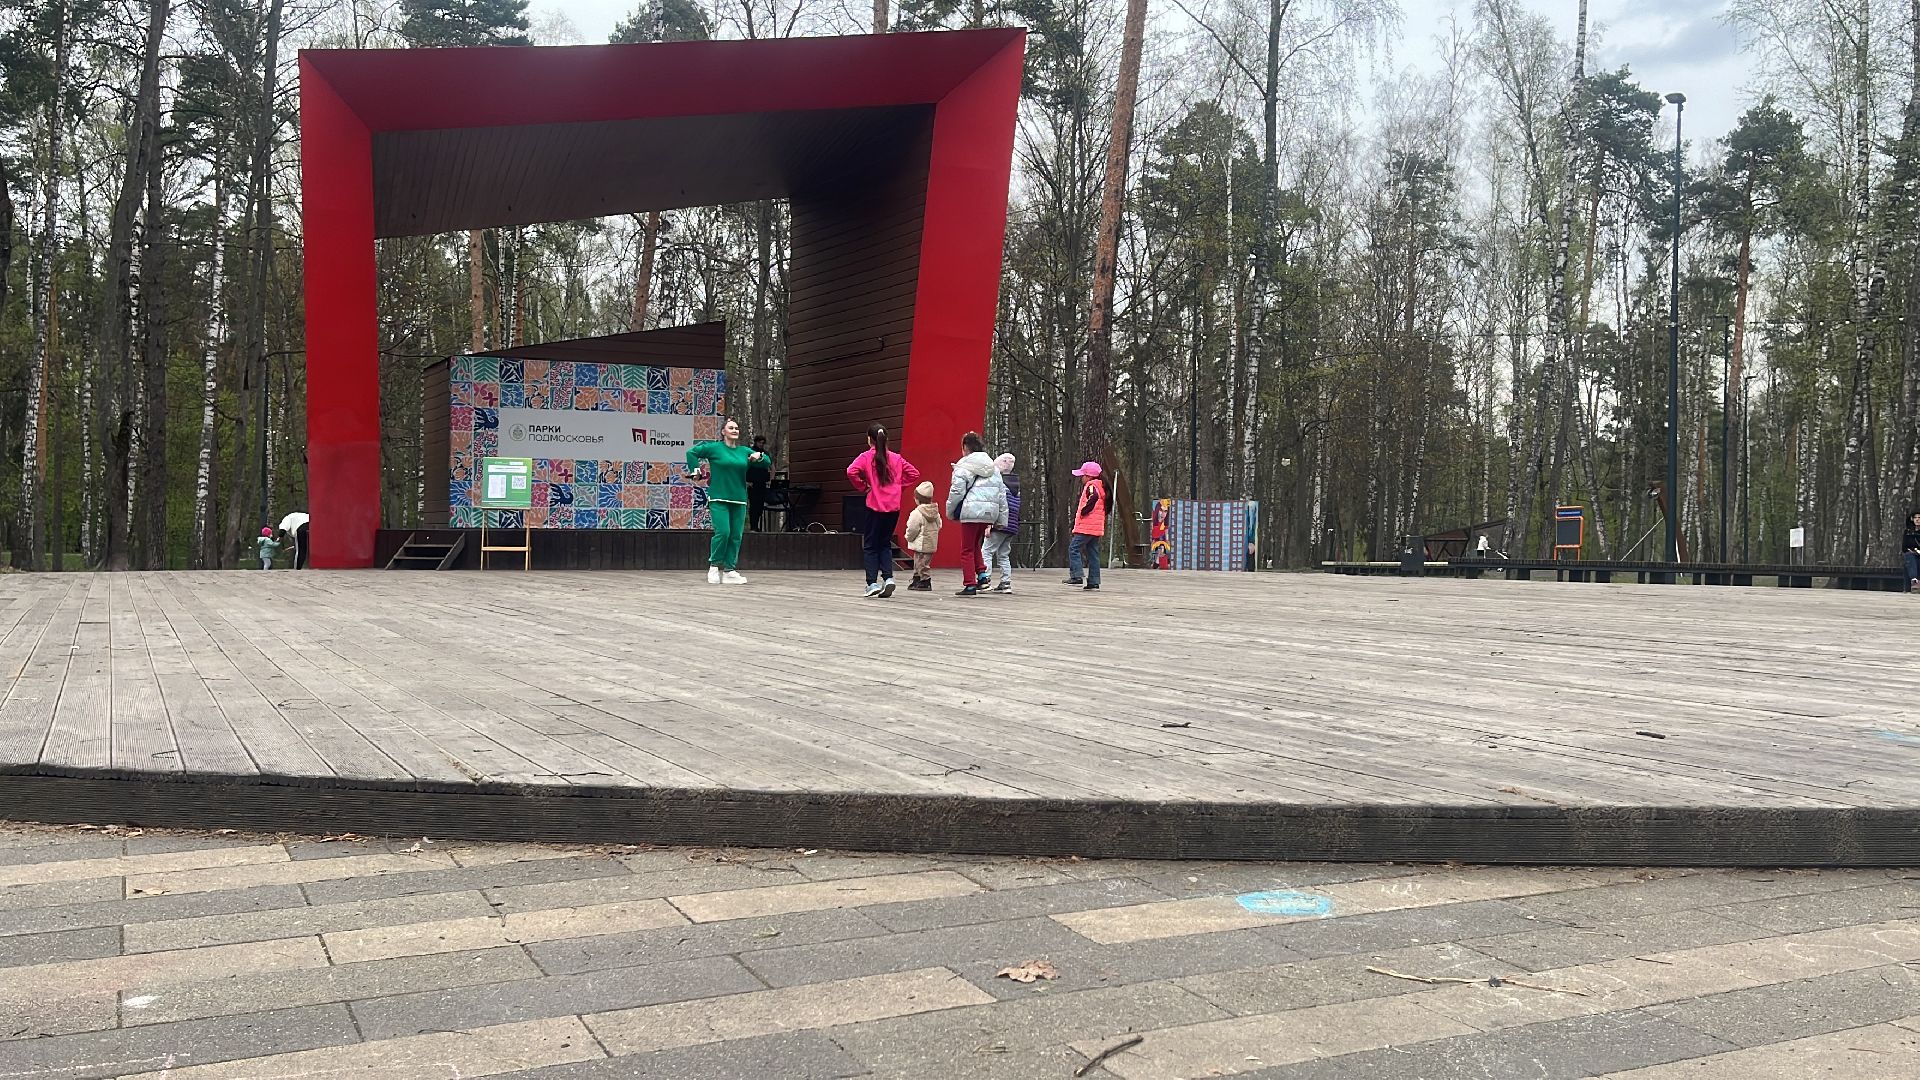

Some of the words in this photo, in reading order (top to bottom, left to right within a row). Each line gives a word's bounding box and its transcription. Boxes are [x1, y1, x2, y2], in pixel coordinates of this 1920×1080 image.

[529, 425, 561, 433] ПАРКИ
[528, 433, 604, 443] ПОДМОСКОВЬЯ
[649, 429, 671, 439] Парк
[649, 438, 685, 447] Пехорка
